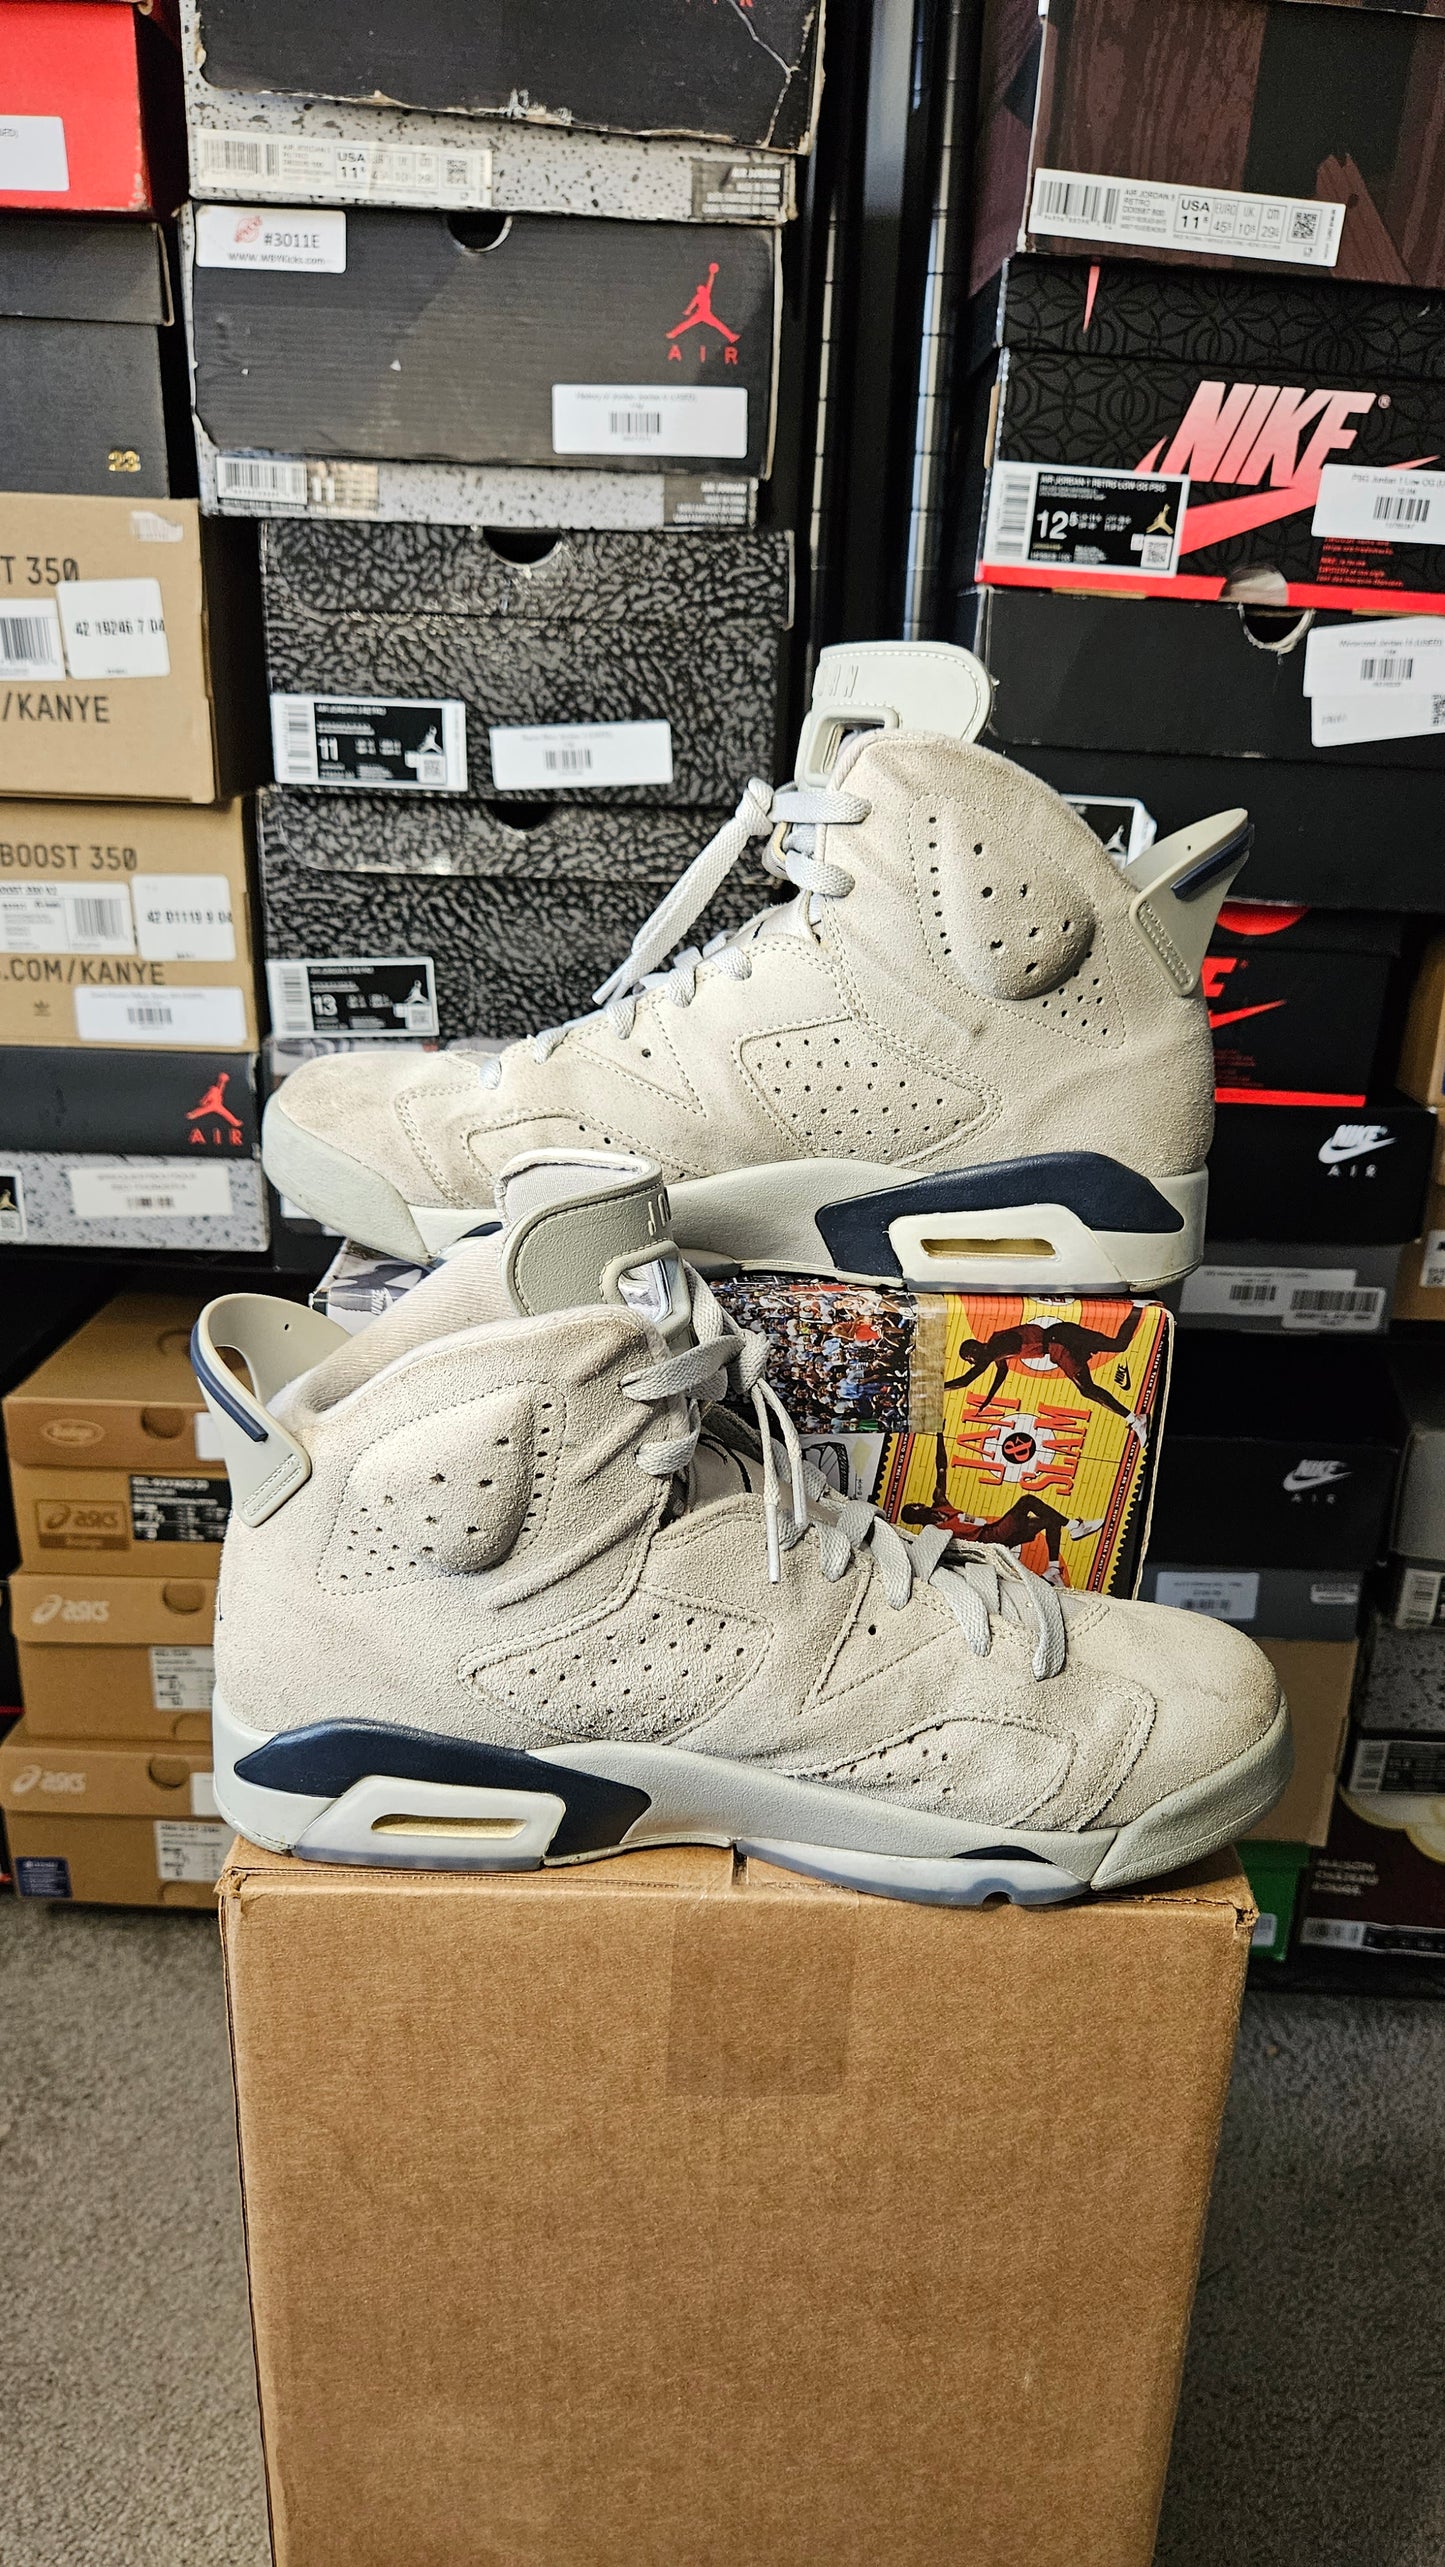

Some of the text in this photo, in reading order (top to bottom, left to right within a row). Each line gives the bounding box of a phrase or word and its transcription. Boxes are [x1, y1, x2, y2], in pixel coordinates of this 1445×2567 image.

[338, 152, 366, 163] USA
[1181, 199, 1210, 212] USA
[264, 232, 321, 248] #3011E
[667, 344, 740, 365] AIR
[1159, 379, 1377, 488] NIKE
[107, 450, 142, 473] 23
[0, 555, 16, 584] T
[0, 843, 138, 871] BOOST 350
[312, 993, 338, 1016] 13
[188, 1127, 243, 1146] AIR
[1331, 1124, 1382, 1148] NIKE
[1327, 1164, 1377, 1178] AIR
[1114, 1362, 1126, 1386] NIKE
[951, 1391, 1021, 1485] JAM
[1003, 1436, 1033, 1462] &
[1019, 1401, 1092, 1496] SLAM
[1294, 1458, 1340, 1478] NIKE
[1291, 1493, 1337, 1504] AIR
[61, 1600, 110, 1623] asics
